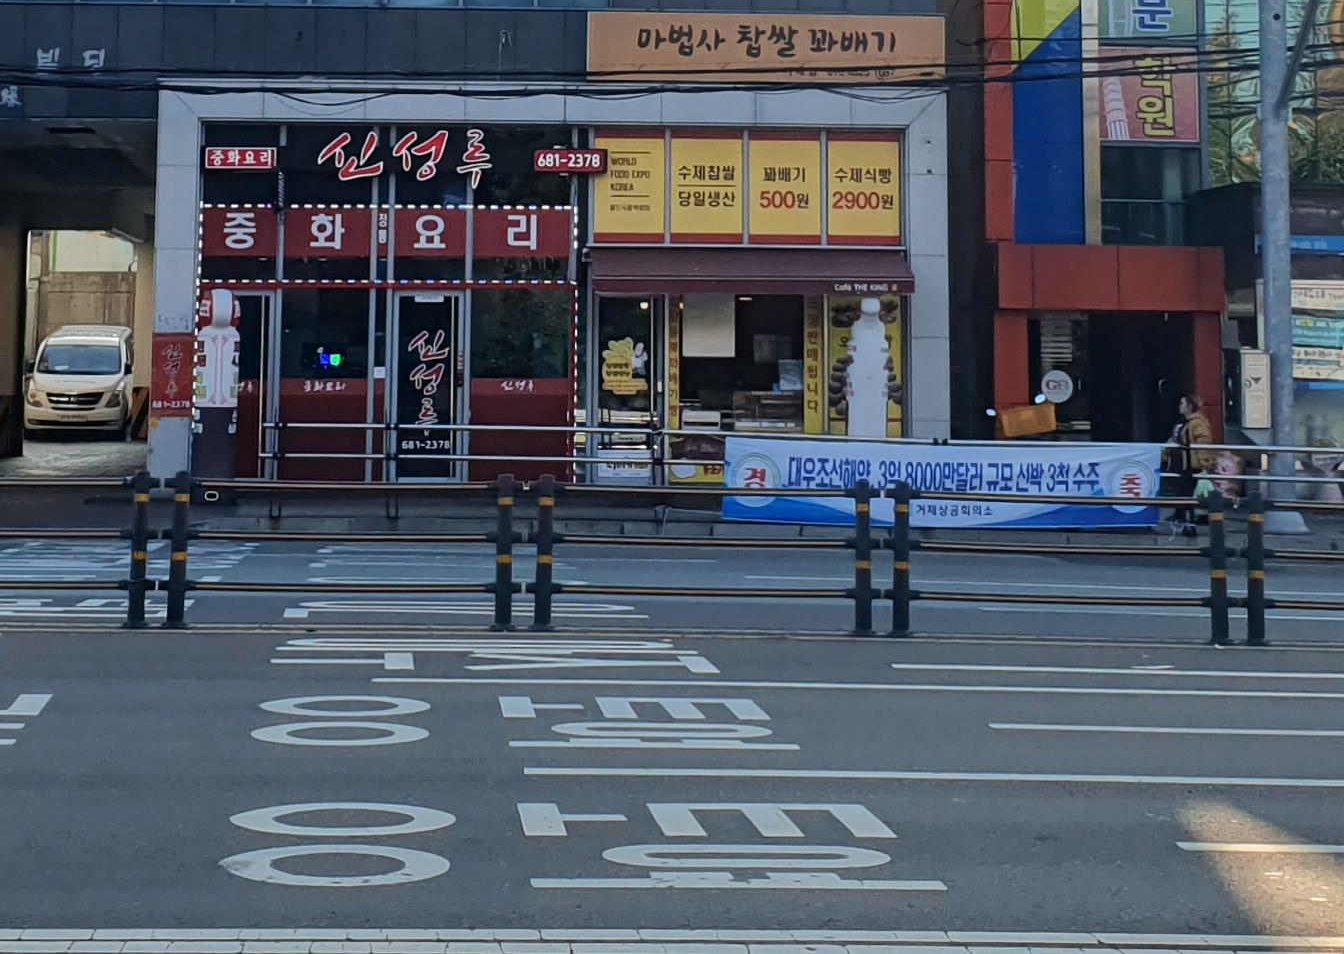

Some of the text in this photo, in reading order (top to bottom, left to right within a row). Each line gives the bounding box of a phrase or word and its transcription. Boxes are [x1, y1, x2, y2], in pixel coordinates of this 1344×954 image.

[637, 23, 897, 59] 마법사 찹쌀 꽈배기
[1132, 55, 1176, 139] 학원
[208, 128, 601, 190] 중화요리 신성루 681-2378
[611, 156, 638, 167] WORLD
[610, 169, 651, 180] FOOD EXPO
[677, 164, 736, 183] 수제찹쌀
[762, 166, 806, 183] 꽈배기
[834, 167, 893, 185] 수제식빵
[610, 182, 635, 193] KOREA
[677, 190, 736, 208] 당일생산
[759, 190, 810, 210] 500원
[831, 191, 895, 211] 2900원
[222, 211, 538, 252] 중화요리
[151, 399, 192, 409] 681-2378
[401, 439, 451, 451] 681-2378
[904, 461, 984, 492] 8000만달러
[985, 462, 1013, 493] 규모
[1015, 462, 1045, 494] 선박
[1045, 462, 1070, 492] 3척
[1072, 461, 1101, 492] 수주
[915, 504, 993, 517] 거제상공회의소
